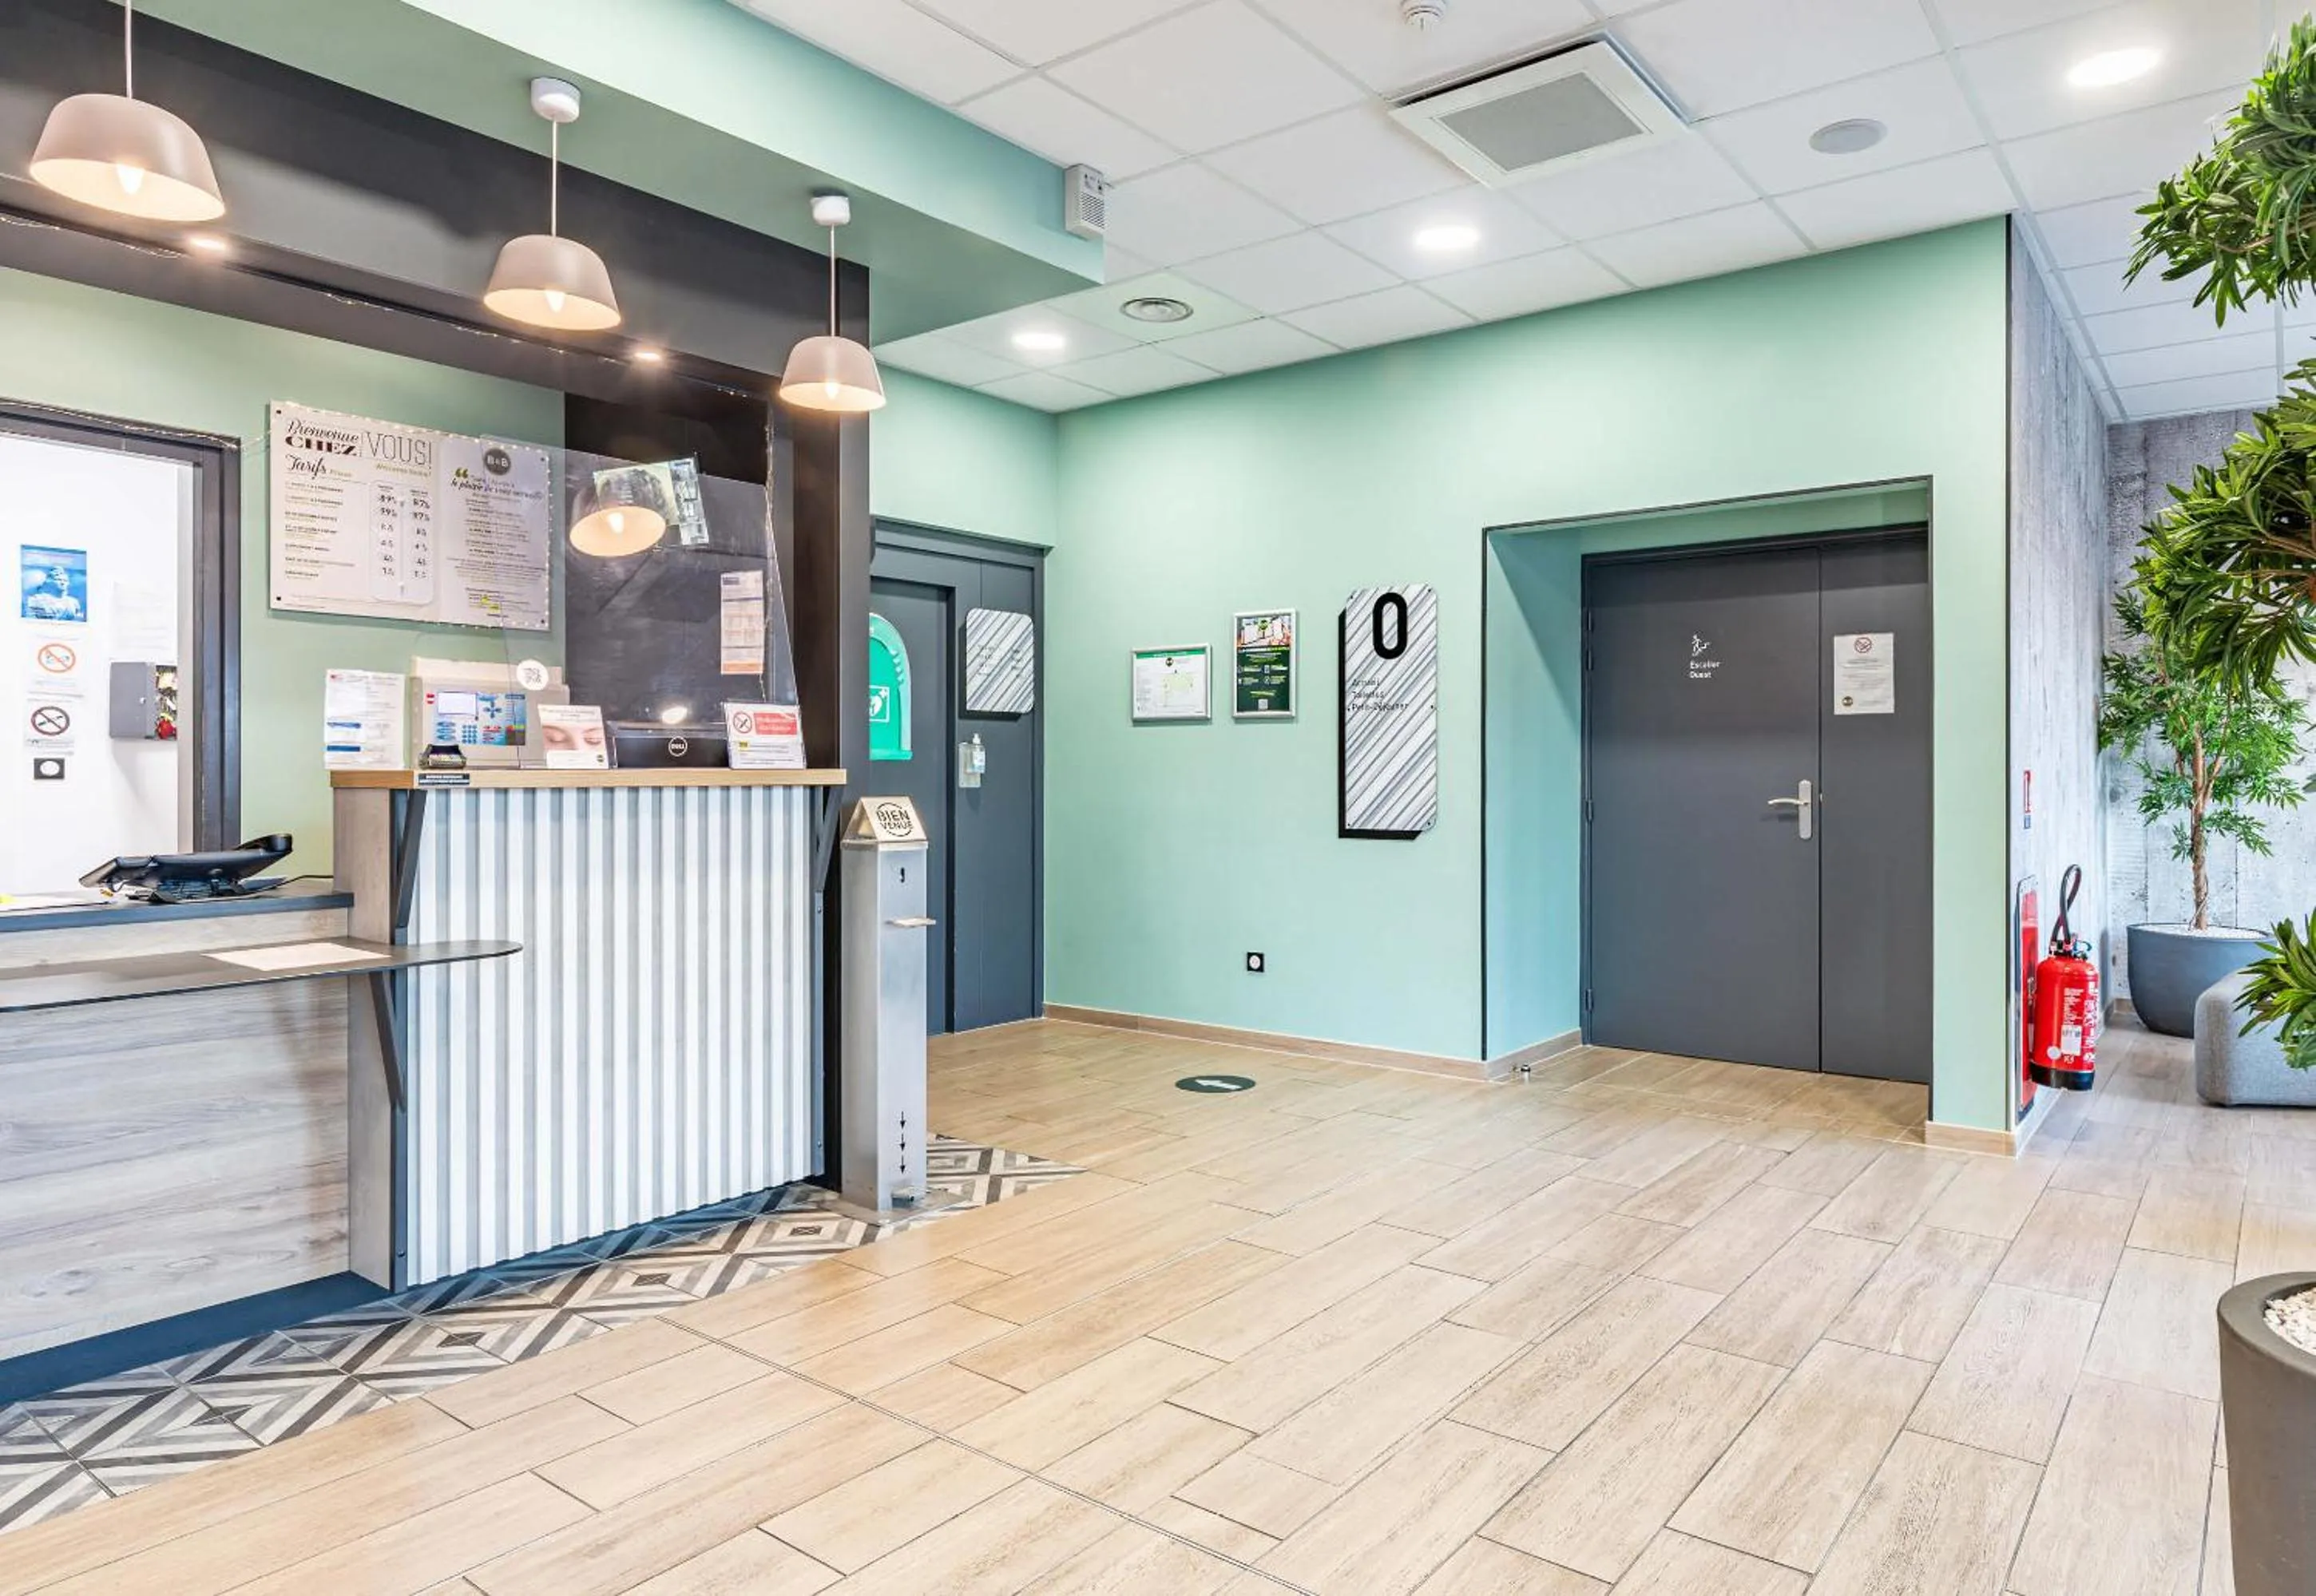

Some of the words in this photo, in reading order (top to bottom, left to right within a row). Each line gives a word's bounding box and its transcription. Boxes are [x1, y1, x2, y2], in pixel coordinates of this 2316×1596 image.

[288, 418, 359, 442] Bienvenue
[285, 435, 358, 457] CHEZ
[367, 431, 432, 469] VOUS!
[285, 453, 327, 480] Tarifs
[876, 810, 910, 822] BIEN
[879, 821, 914, 830] VENUE
